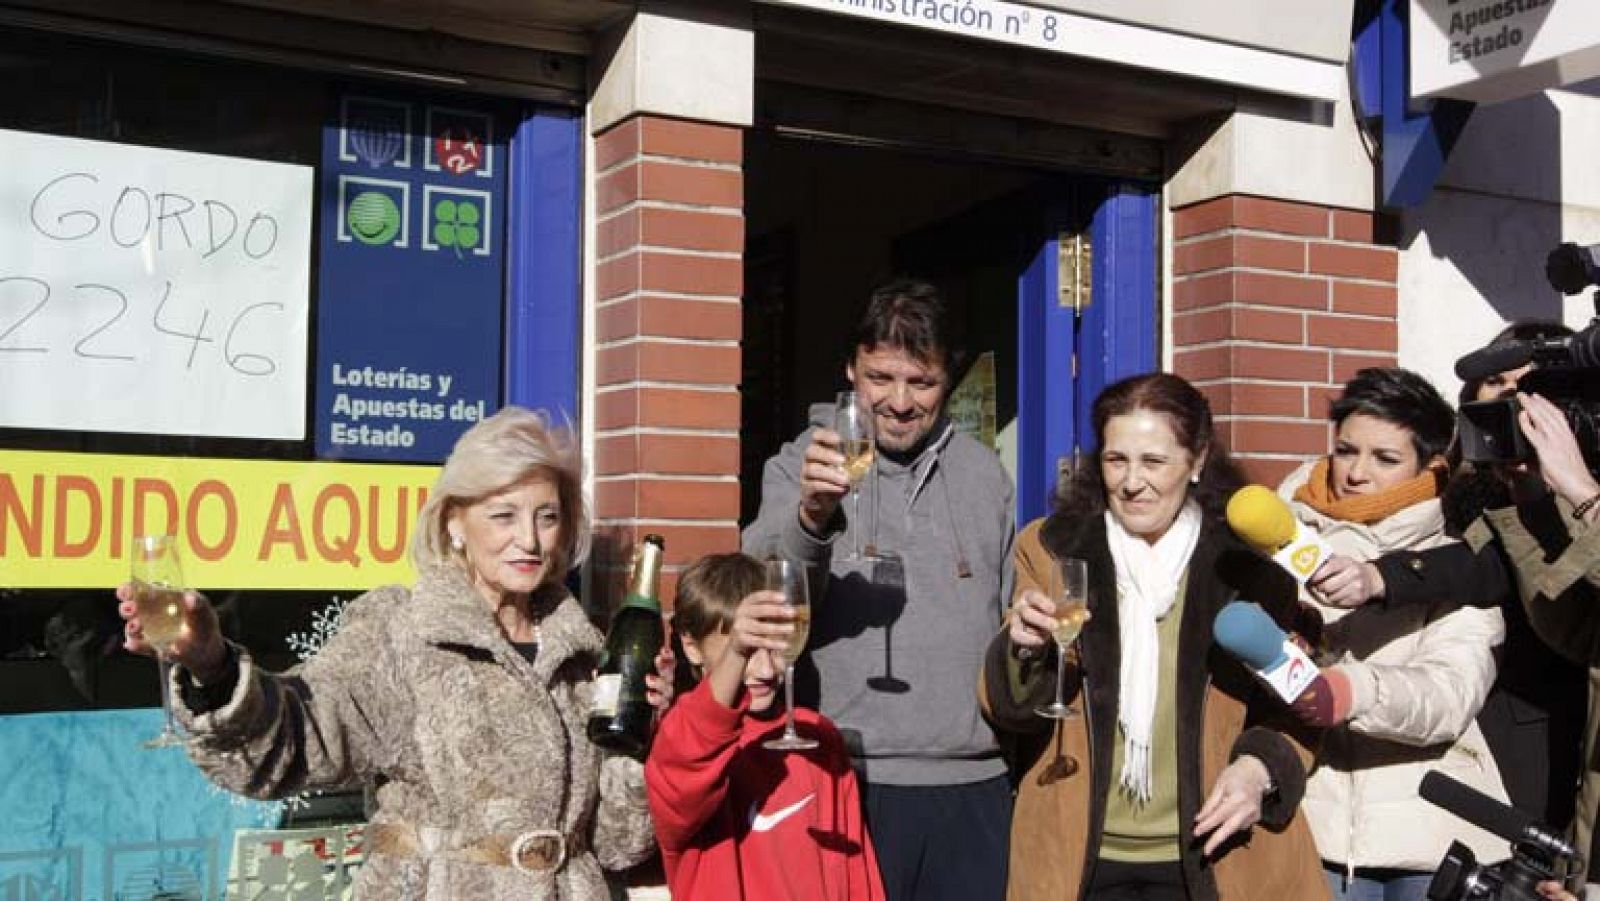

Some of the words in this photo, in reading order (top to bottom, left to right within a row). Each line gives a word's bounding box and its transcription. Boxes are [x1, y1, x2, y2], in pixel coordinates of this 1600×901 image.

[1042, 16, 1057, 41] 8
[31, 173, 278, 259] GORDO
[0, 277, 284, 376] 2246
[332, 363, 432, 391] Loterías
[437, 374, 452, 397] y
[332, 393, 445, 421] Apuestas
[449, 399, 485, 422] del
[330, 422, 416, 448] Estado
[0, 473, 238, 562] NDIDO
[257, 482, 428, 568] AQU
